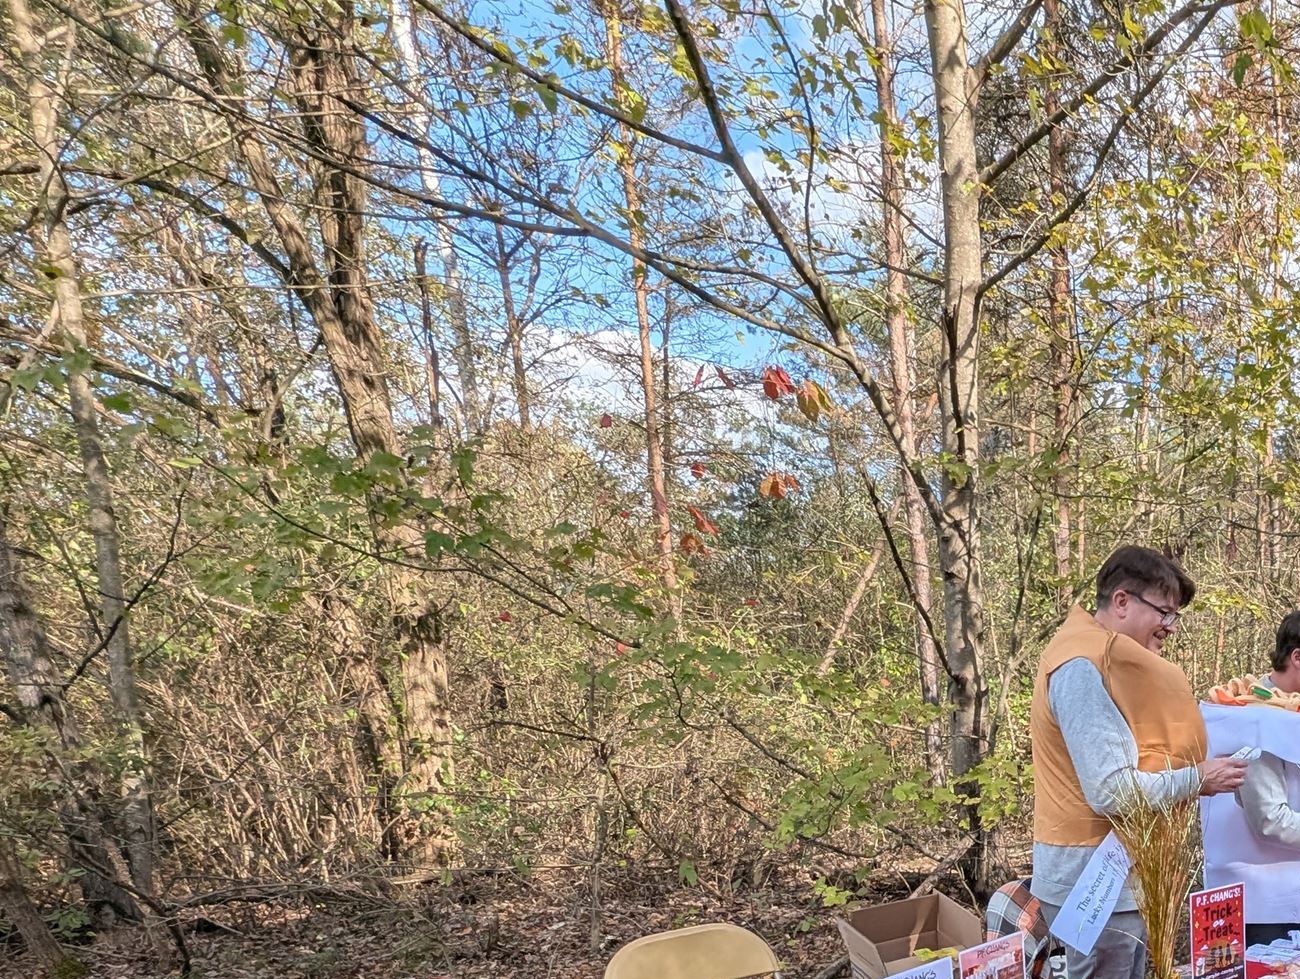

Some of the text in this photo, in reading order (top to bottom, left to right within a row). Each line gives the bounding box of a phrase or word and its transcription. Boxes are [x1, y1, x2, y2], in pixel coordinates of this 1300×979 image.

[1076, 895, 1092, 912] The
[1090, 871, 1106, 897] secret
[1196, 896, 1210, 908] P.F.
[1087, 903, 1104, 925] Lucky
[1202, 923, 1233, 942] Treat
